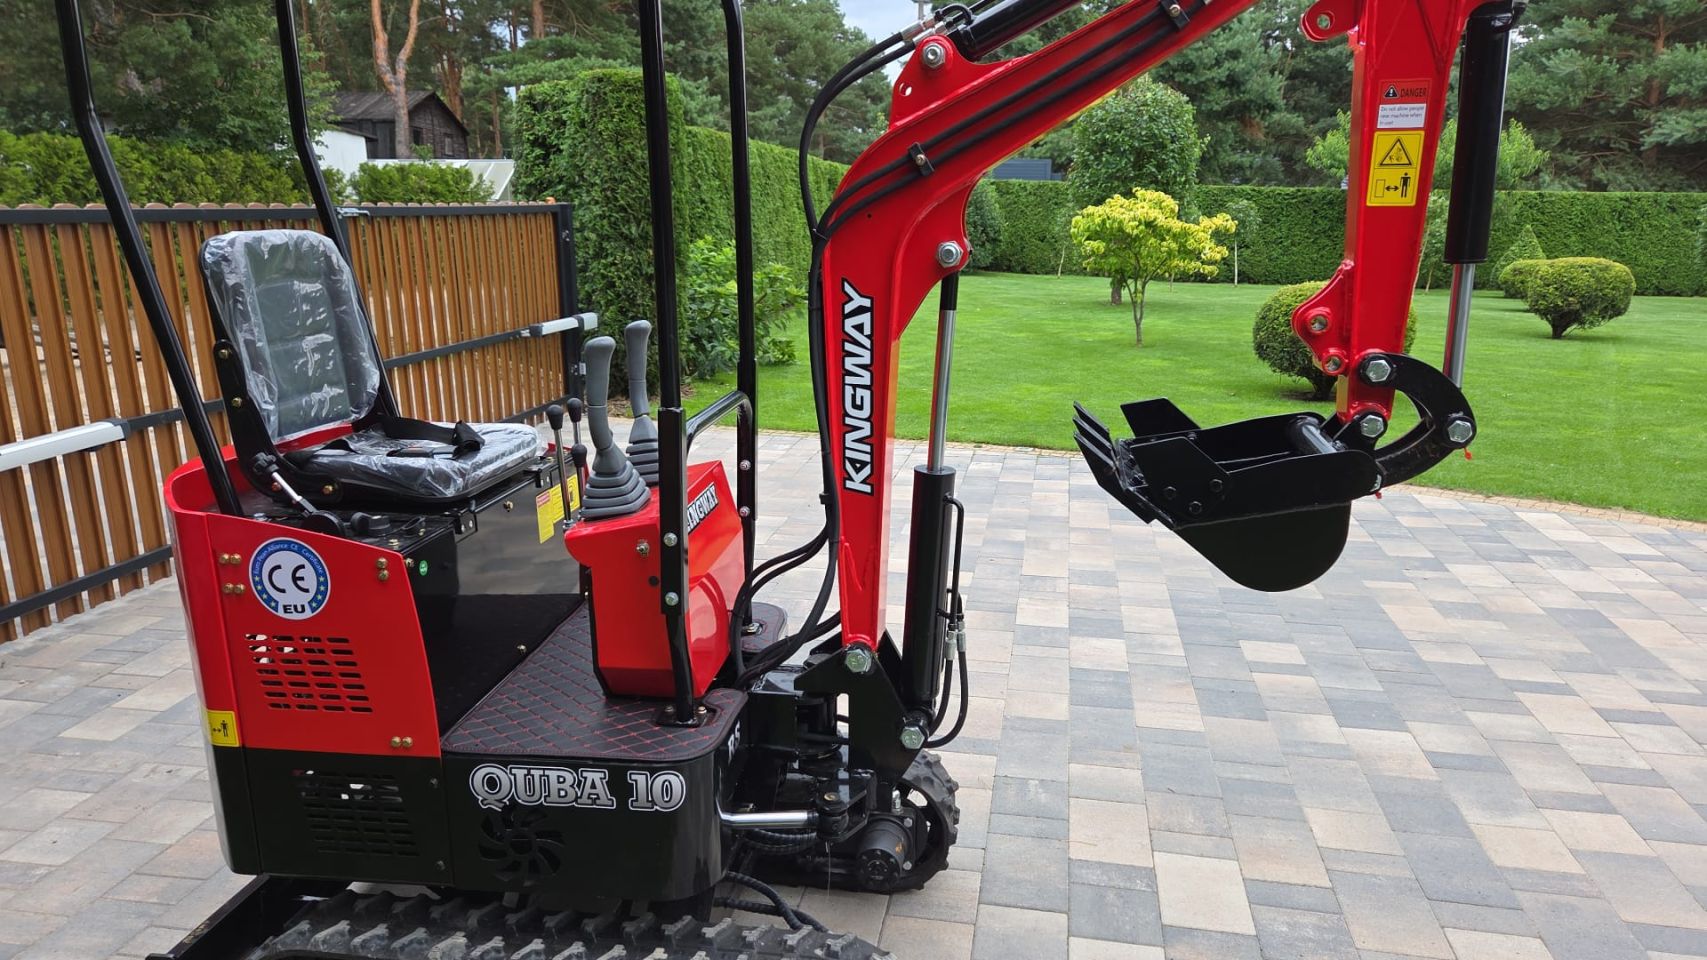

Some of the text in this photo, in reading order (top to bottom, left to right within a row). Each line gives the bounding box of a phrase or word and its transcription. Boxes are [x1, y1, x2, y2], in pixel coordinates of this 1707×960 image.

[1400, 87, 1427, 98] DANGER
[842, 278, 873, 494] KINGWAY
[301, 547, 324, 574] Certificate
[268, 564, 310, 594] CE
[282, 604, 306, 614] EU
[469, 764, 686, 811] QUBA 10
